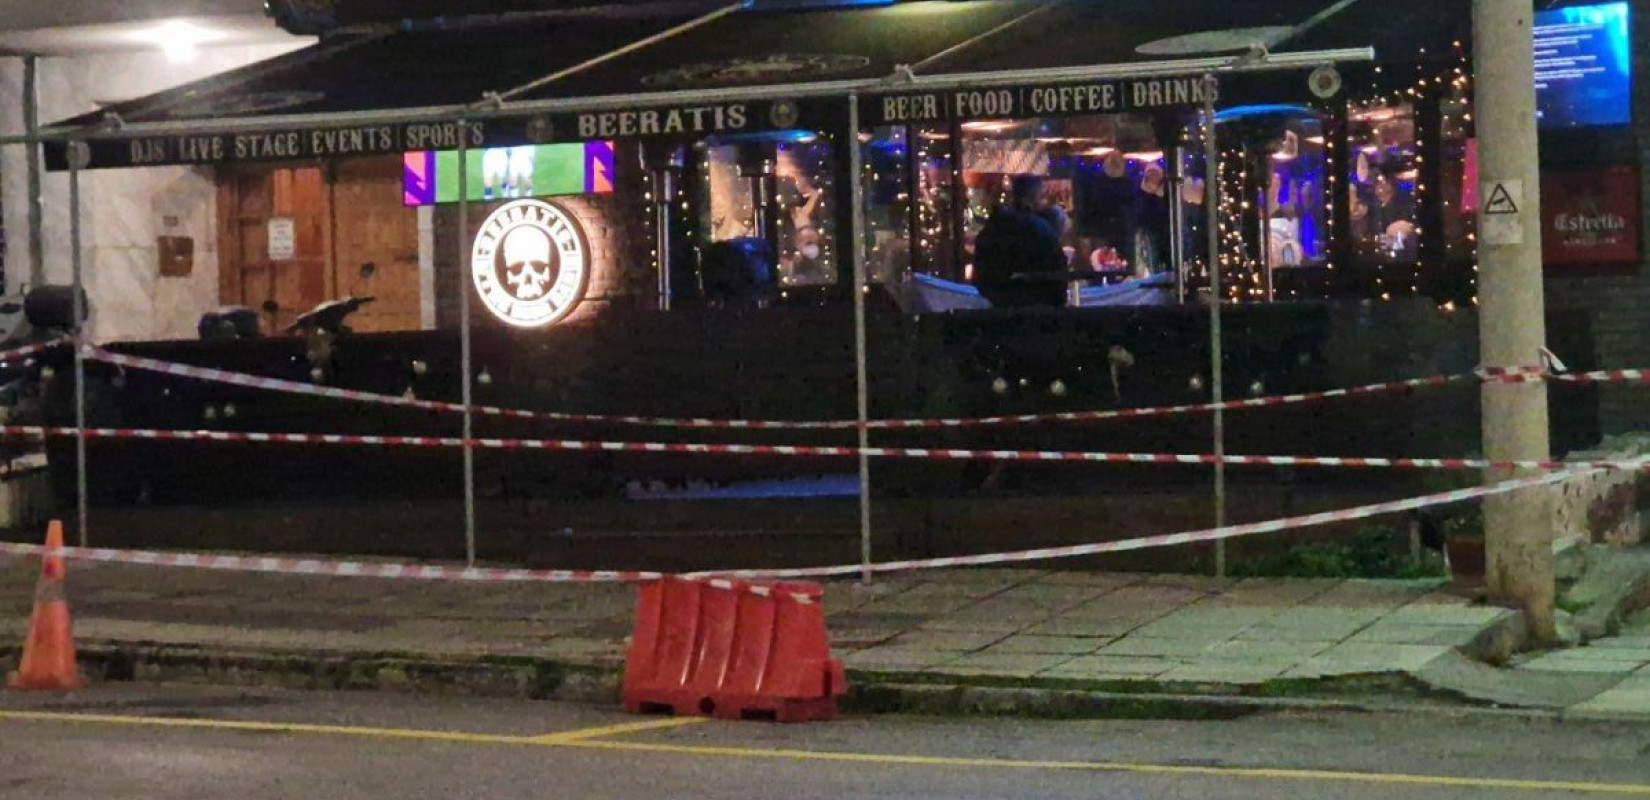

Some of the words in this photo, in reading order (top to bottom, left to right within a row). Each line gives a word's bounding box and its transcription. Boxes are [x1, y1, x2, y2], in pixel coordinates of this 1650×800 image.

[883, 94, 937, 121] BEER
[956, 90, 1013, 116] FOOD
[1030, 84, 1115, 112] COFFEE
[577, 104, 747, 138] BEERATIS
[178, 136, 223, 161] LIVE
[235, 132, 299, 158] STAGE
[312, 126, 392, 153] EVENTS
